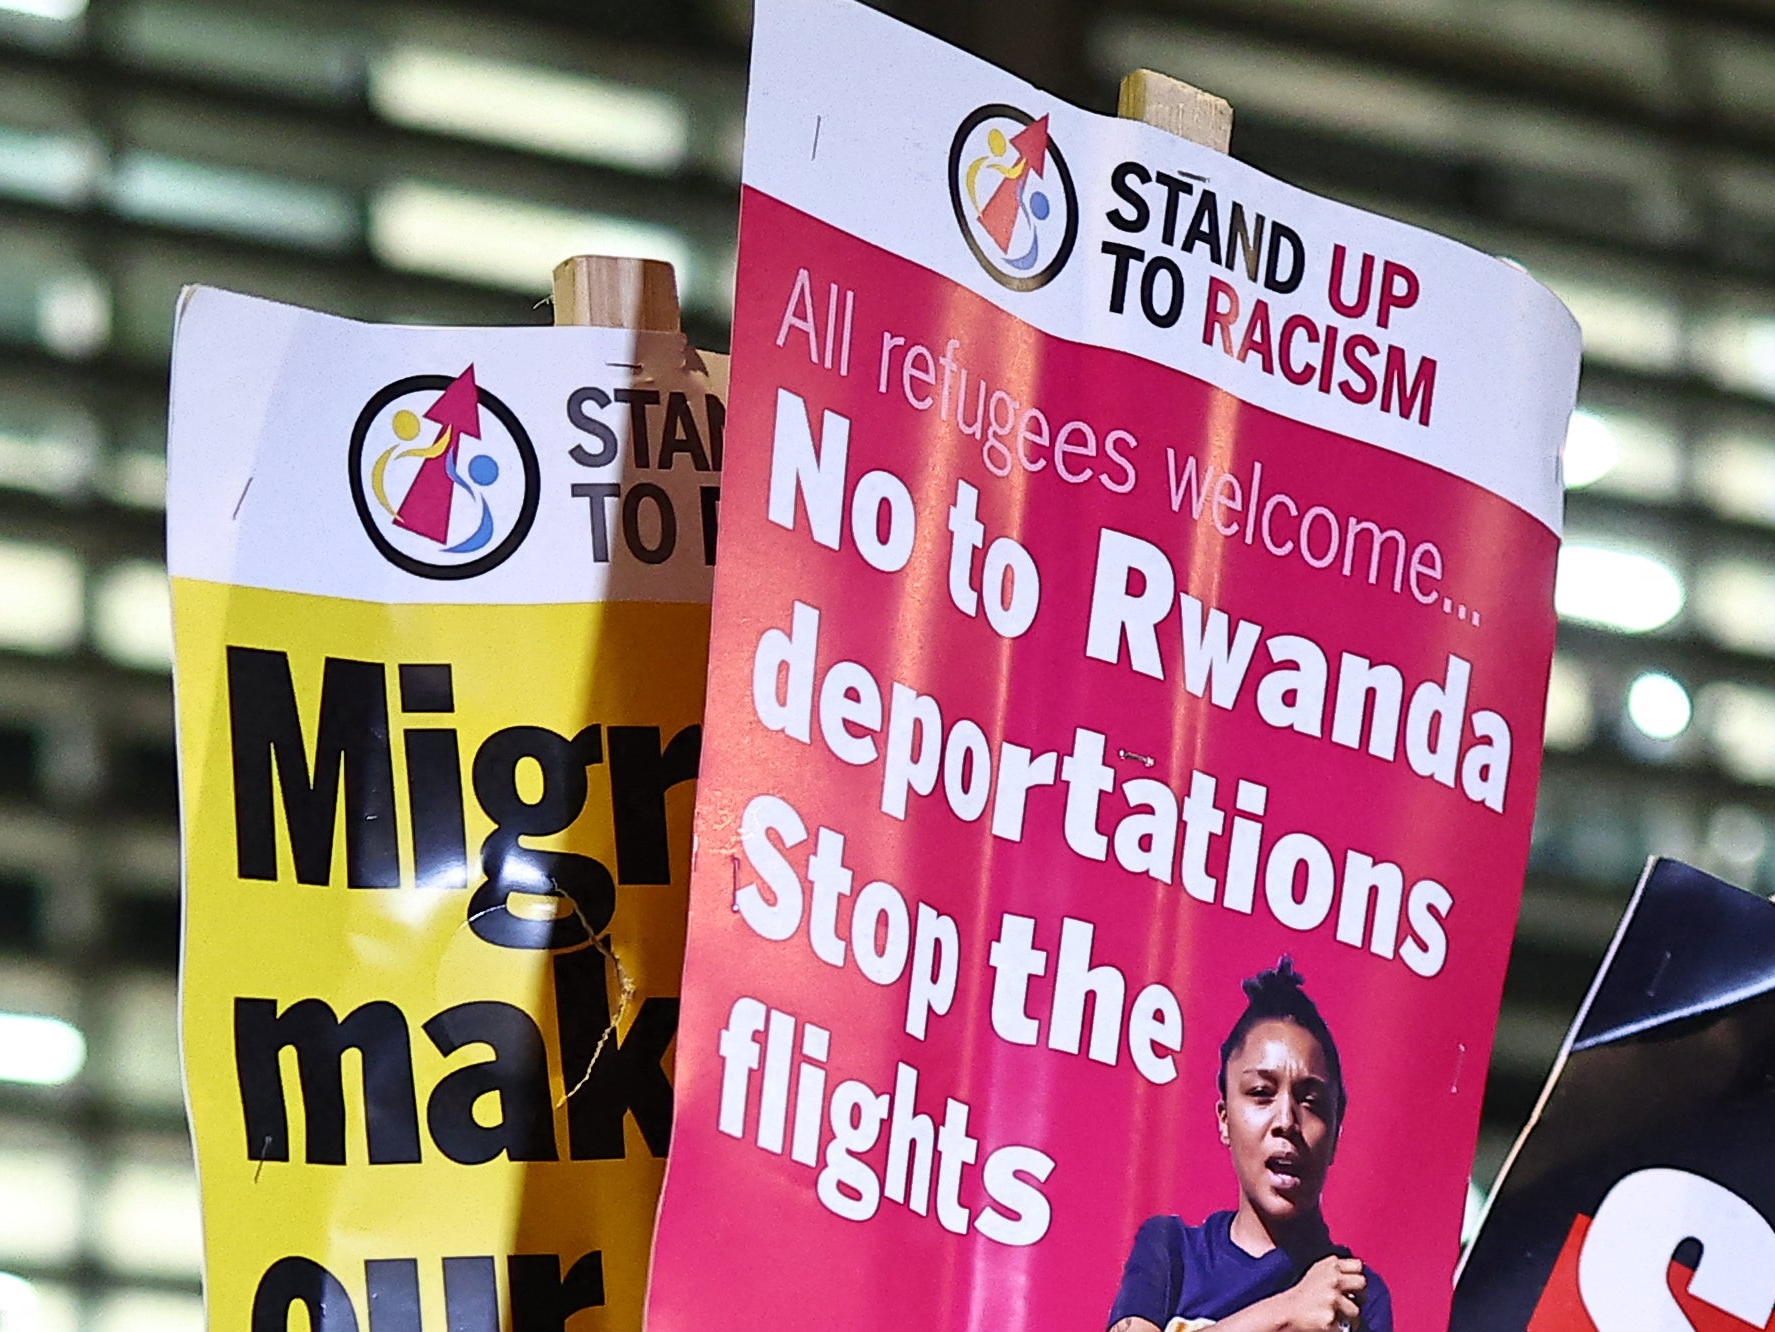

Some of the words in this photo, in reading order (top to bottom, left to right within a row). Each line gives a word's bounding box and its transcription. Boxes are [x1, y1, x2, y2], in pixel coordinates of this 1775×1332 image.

[1100, 242, 1185, 330] TO
[1200, 290, 1438, 428] RACISM
[1101, 160, 1305, 296] STAND
[1328, 245, 1421, 327] UP
[571, 482, 676, 565] TO
[773, 266, 856, 374] All
[877, 329, 1139, 493] refugees
[1166, 444, 1483, 630] welcome...
[766, 392, 916, 575] No
[945, 479, 1040, 640] to
[1084, 526, 1513, 815] Rwanda
[226, 643, 703, 953] Migr
[750, 608, 1454, 980] deportations
[233, 934, 678, 1168] mak
[732, 794, 961, 1042] Stop
[989, 915, 1184, 1086] the
[713, 993, 1054, 1247] flights
